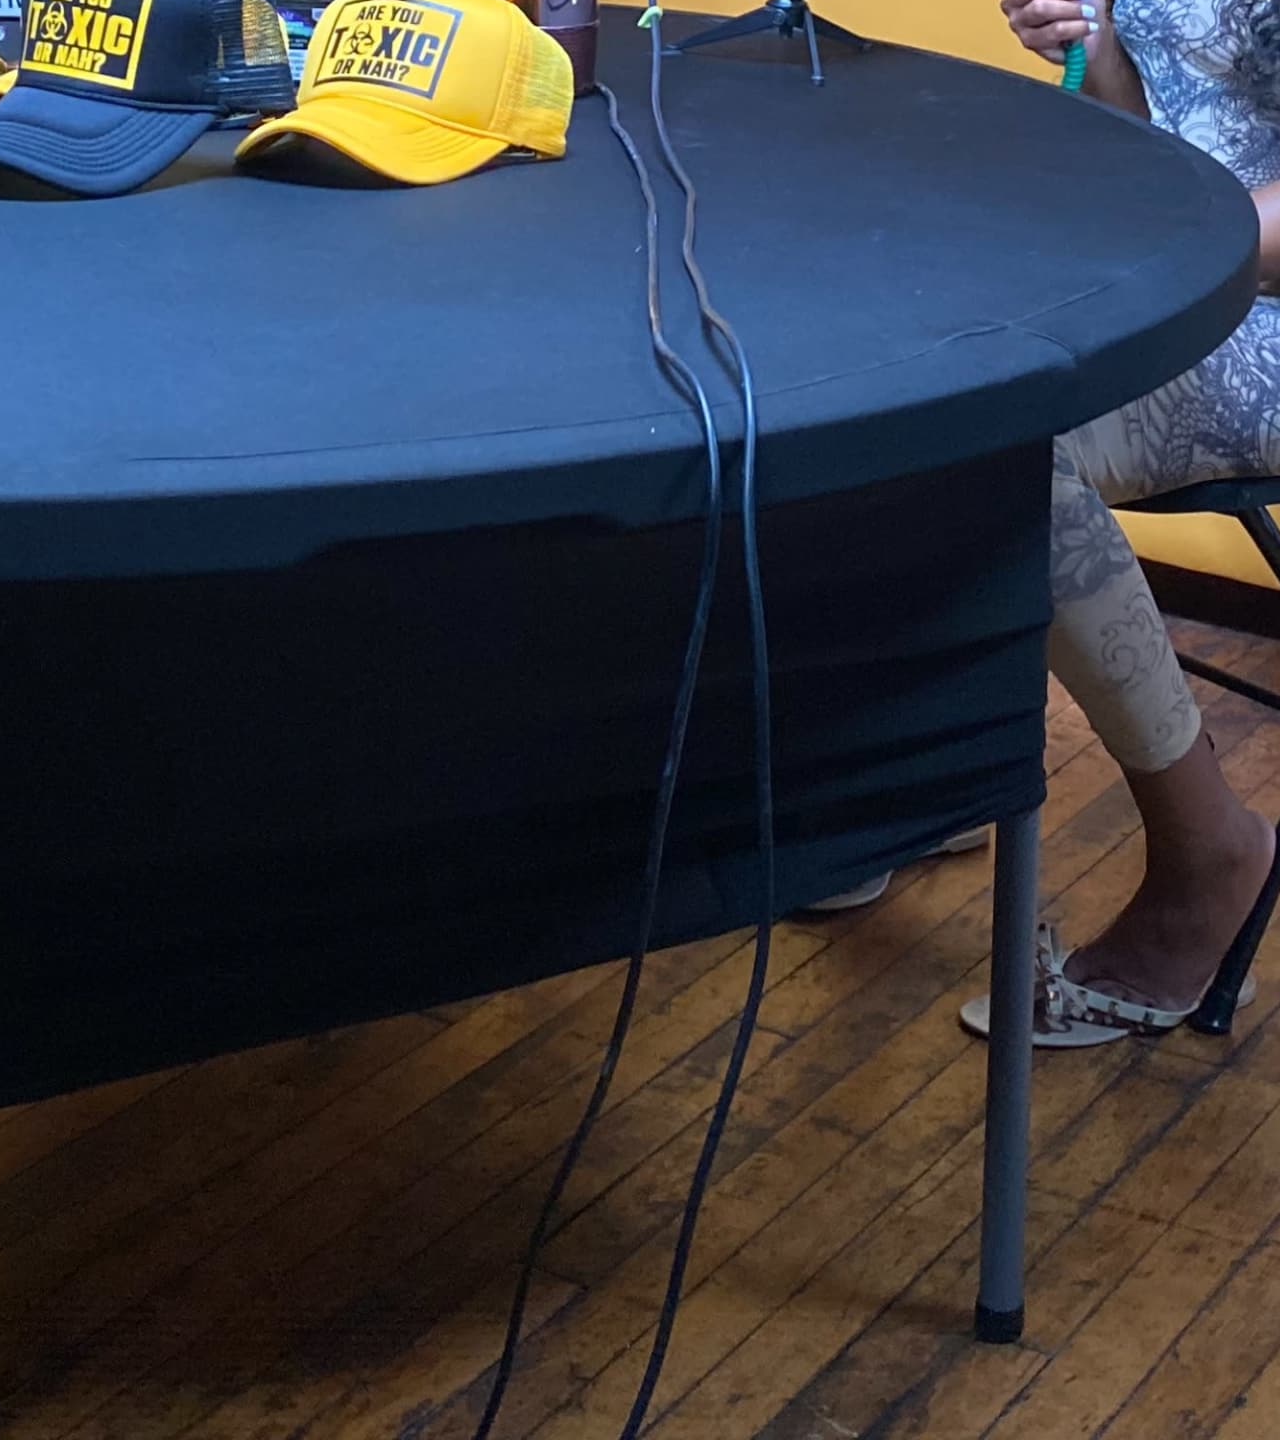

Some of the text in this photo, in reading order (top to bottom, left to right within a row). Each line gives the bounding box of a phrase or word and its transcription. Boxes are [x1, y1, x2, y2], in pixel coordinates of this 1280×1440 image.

[356, 5, 424, 25] ARE YOU
[33, 41, 107, 73] OR NAH?
[332, 59, 410, 82] OR NAH?
